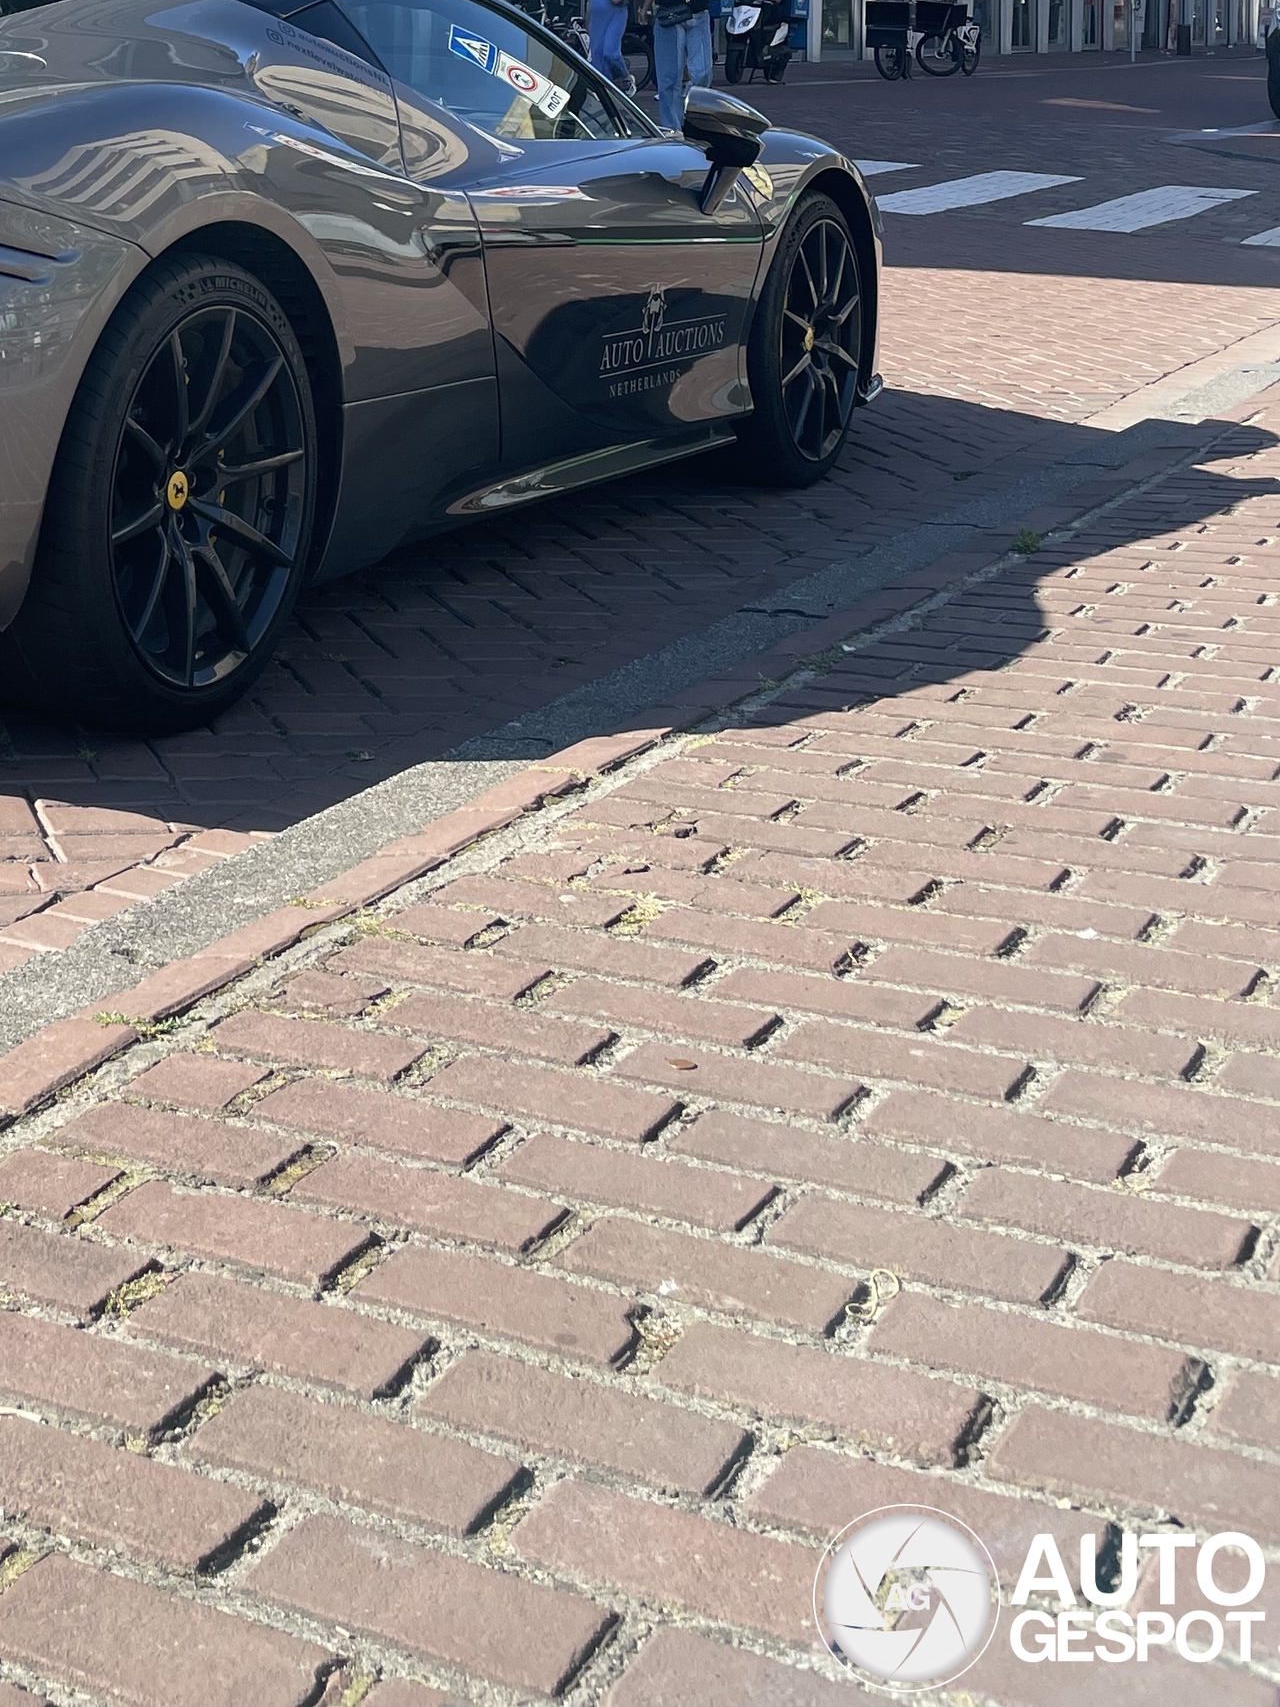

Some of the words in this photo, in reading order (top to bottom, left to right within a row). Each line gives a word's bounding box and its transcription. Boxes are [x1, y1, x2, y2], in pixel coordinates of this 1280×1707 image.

[215, 276, 267, 310] MICHELIN
[600, 339, 644, 370] AUTO
[655, 321, 725, 358] AUCTIONS
[609, 369, 681, 398] NETHERLANDS
